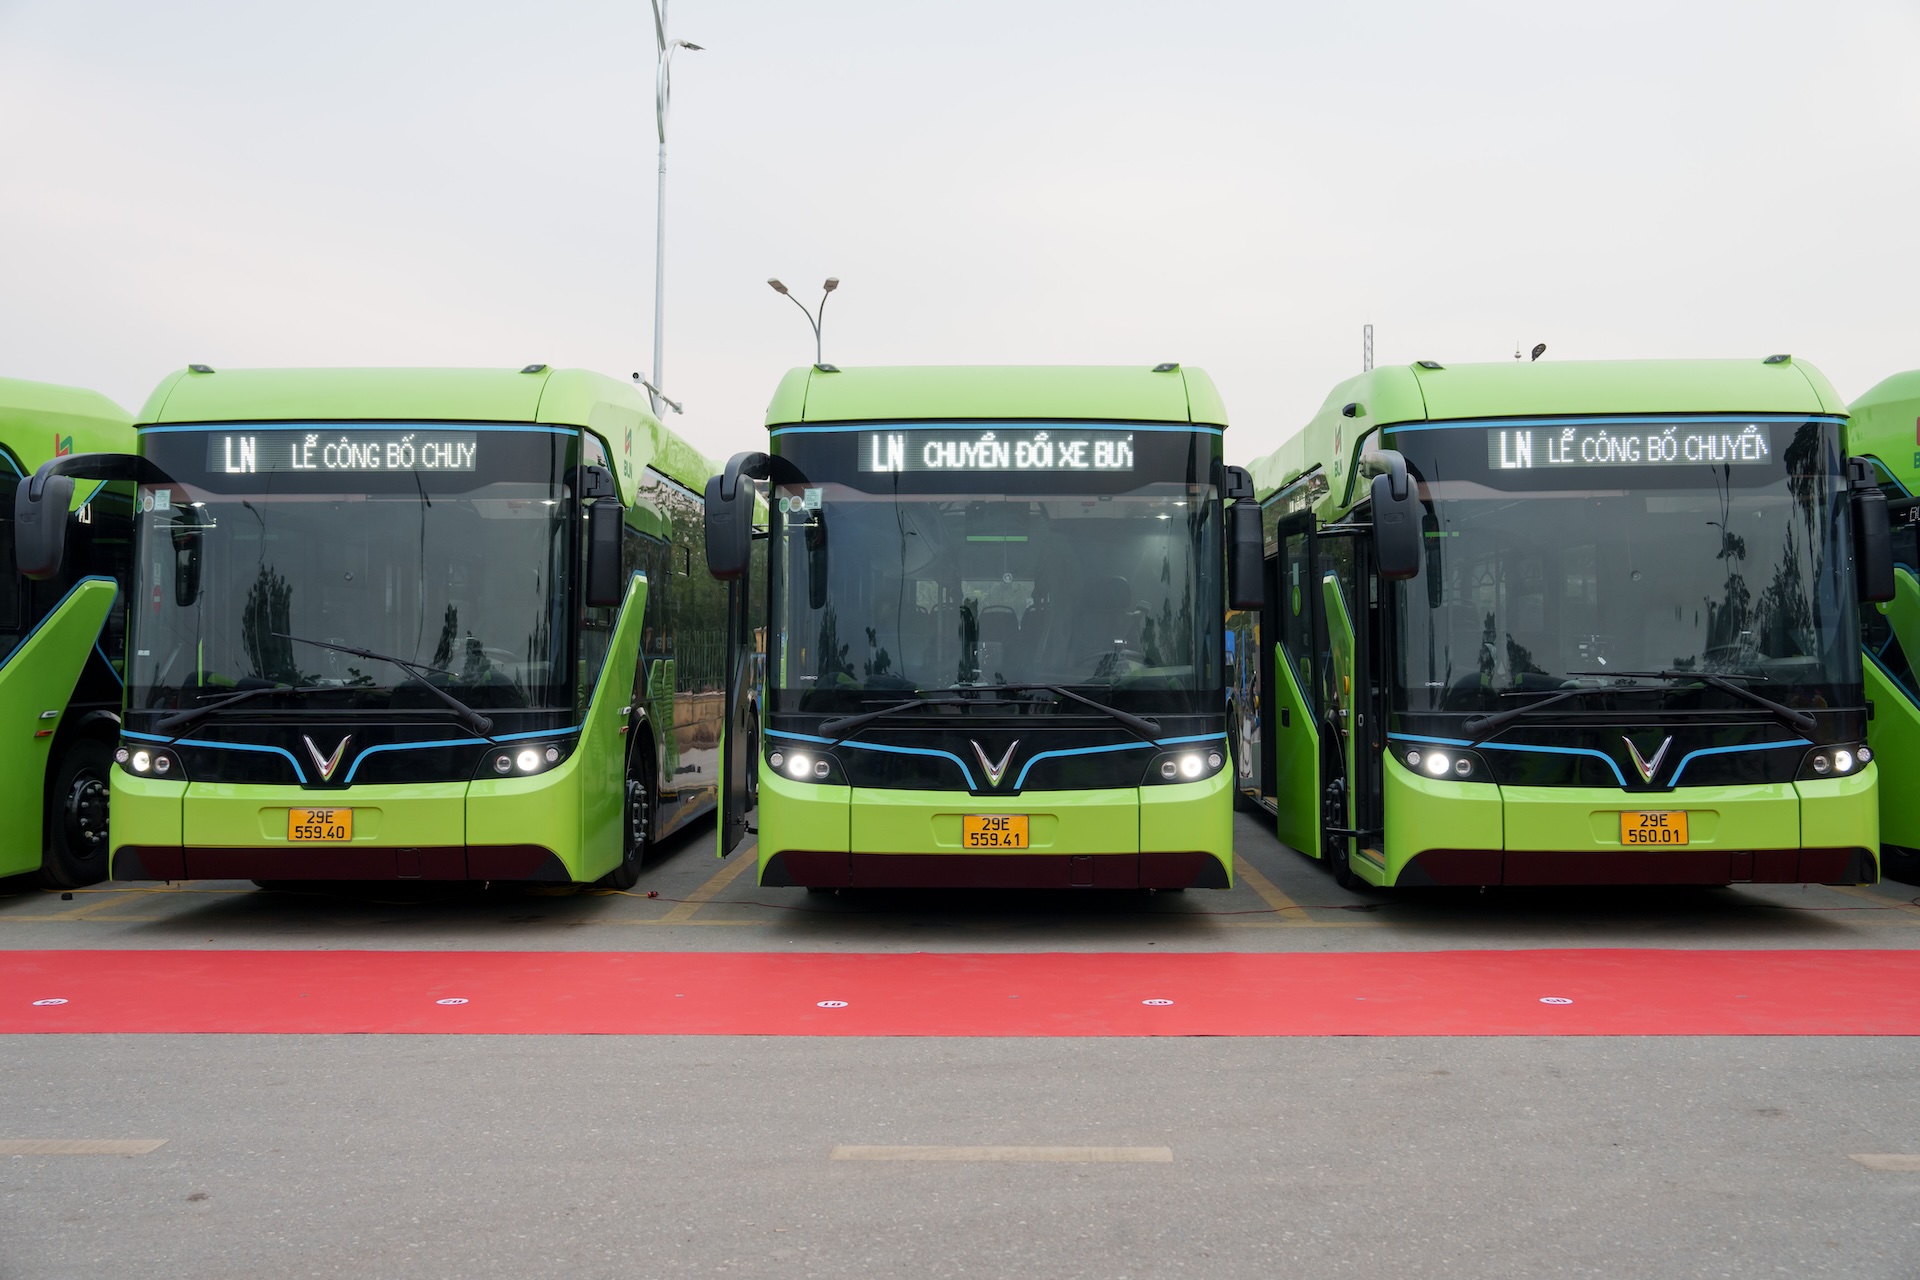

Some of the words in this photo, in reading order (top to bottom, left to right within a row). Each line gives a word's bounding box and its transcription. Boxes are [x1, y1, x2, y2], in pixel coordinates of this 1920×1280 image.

[225, 436, 256, 473] LN
[292, 434, 318, 468] LỄ
[324, 437, 380, 468] CÔNG
[387, 433, 415, 468] BỐ
[422, 442, 476, 468] CHUY
[872, 434, 904, 471] LN
[923, 431, 1010, 468] CHUYỂN
[1015, 431, 1053, 468] ĐỔI
[1058, 441, 1089, 467] XE
[1500, 431, 1532, 468] LN
[1549, 428, 1576, 462] LỄ
[1582, 430, 1640, 462] CÔNG
[1648, 426, 1677, 461] BỐ
[307, 811, 334, 824] 29E
[982, 817, 1010, 831] 29E
[1640, 813, 1668, 827] 29E
[295, 825, 345, 839] 559.40
[1629, 829, 1679, 843] 560.01
[971, 833, 1020, 846] 559.41
